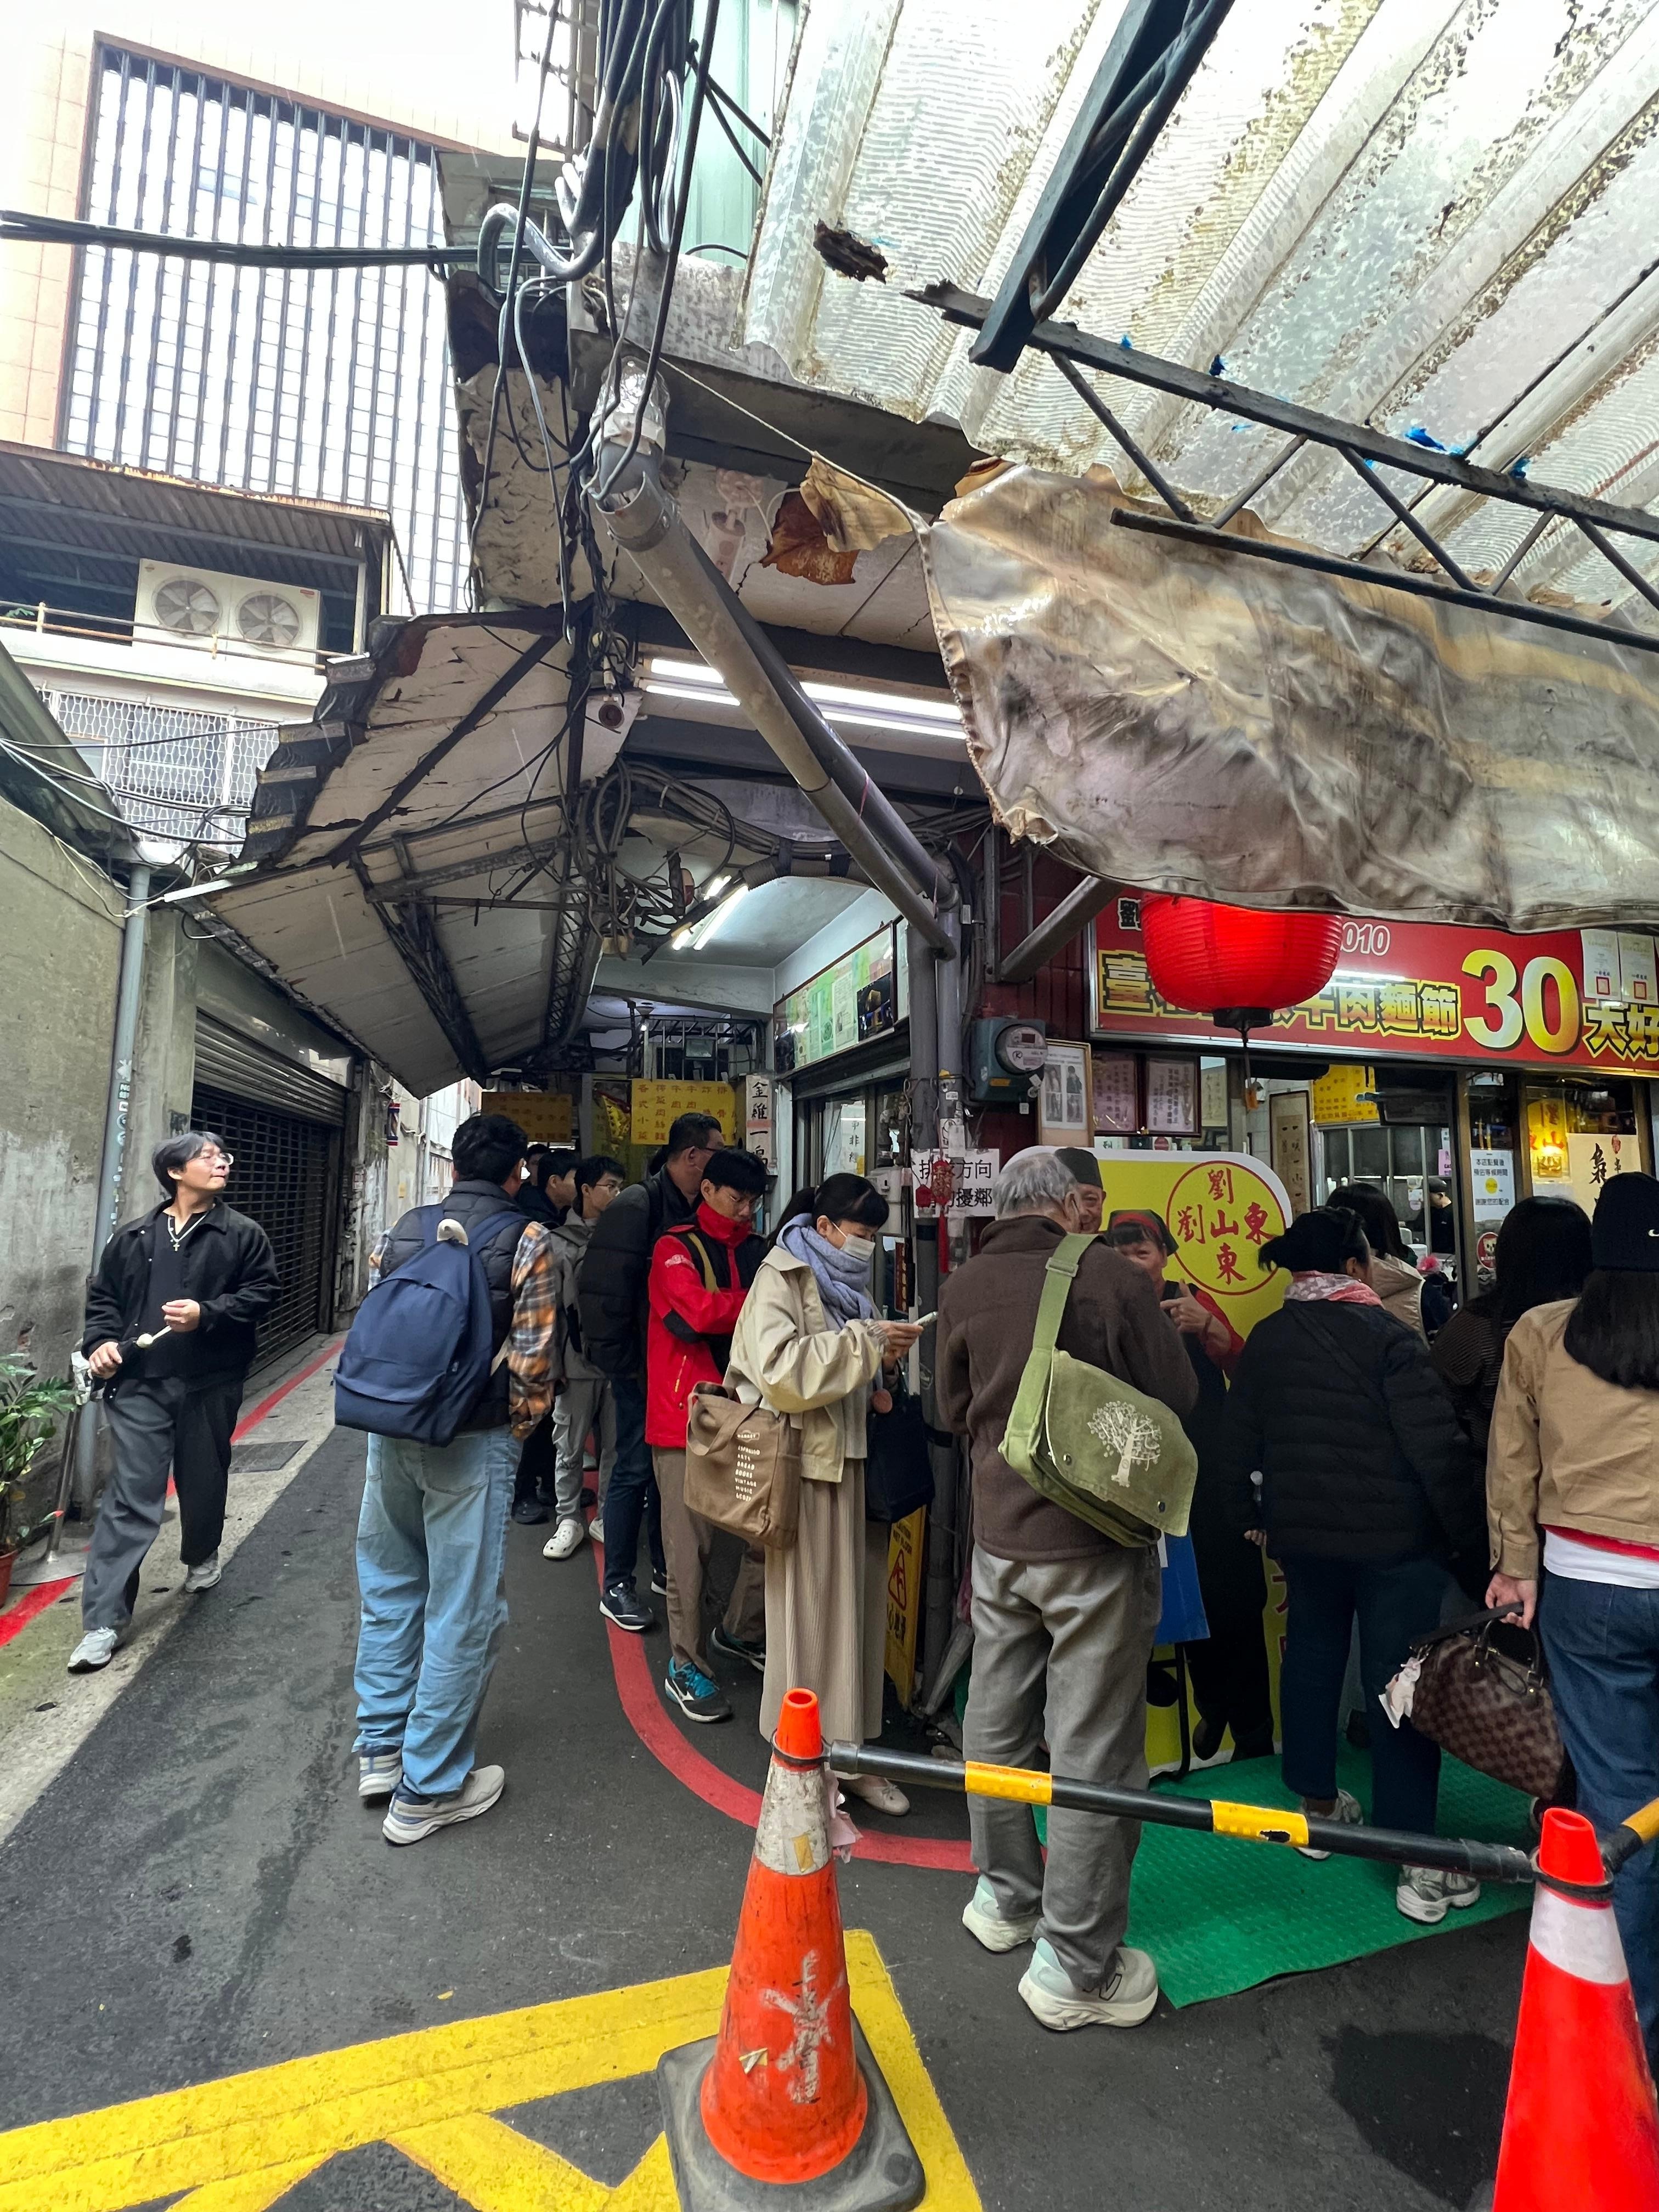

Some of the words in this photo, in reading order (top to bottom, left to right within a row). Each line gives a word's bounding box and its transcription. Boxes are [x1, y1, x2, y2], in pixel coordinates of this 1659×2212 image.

[1340, 921, 1391, 956] 010
[1461, 949, 1579, 1053] 30
[919, 1159, 992, 1180] 排方向
[735, 1477, 757, 1487] VINTAGE
